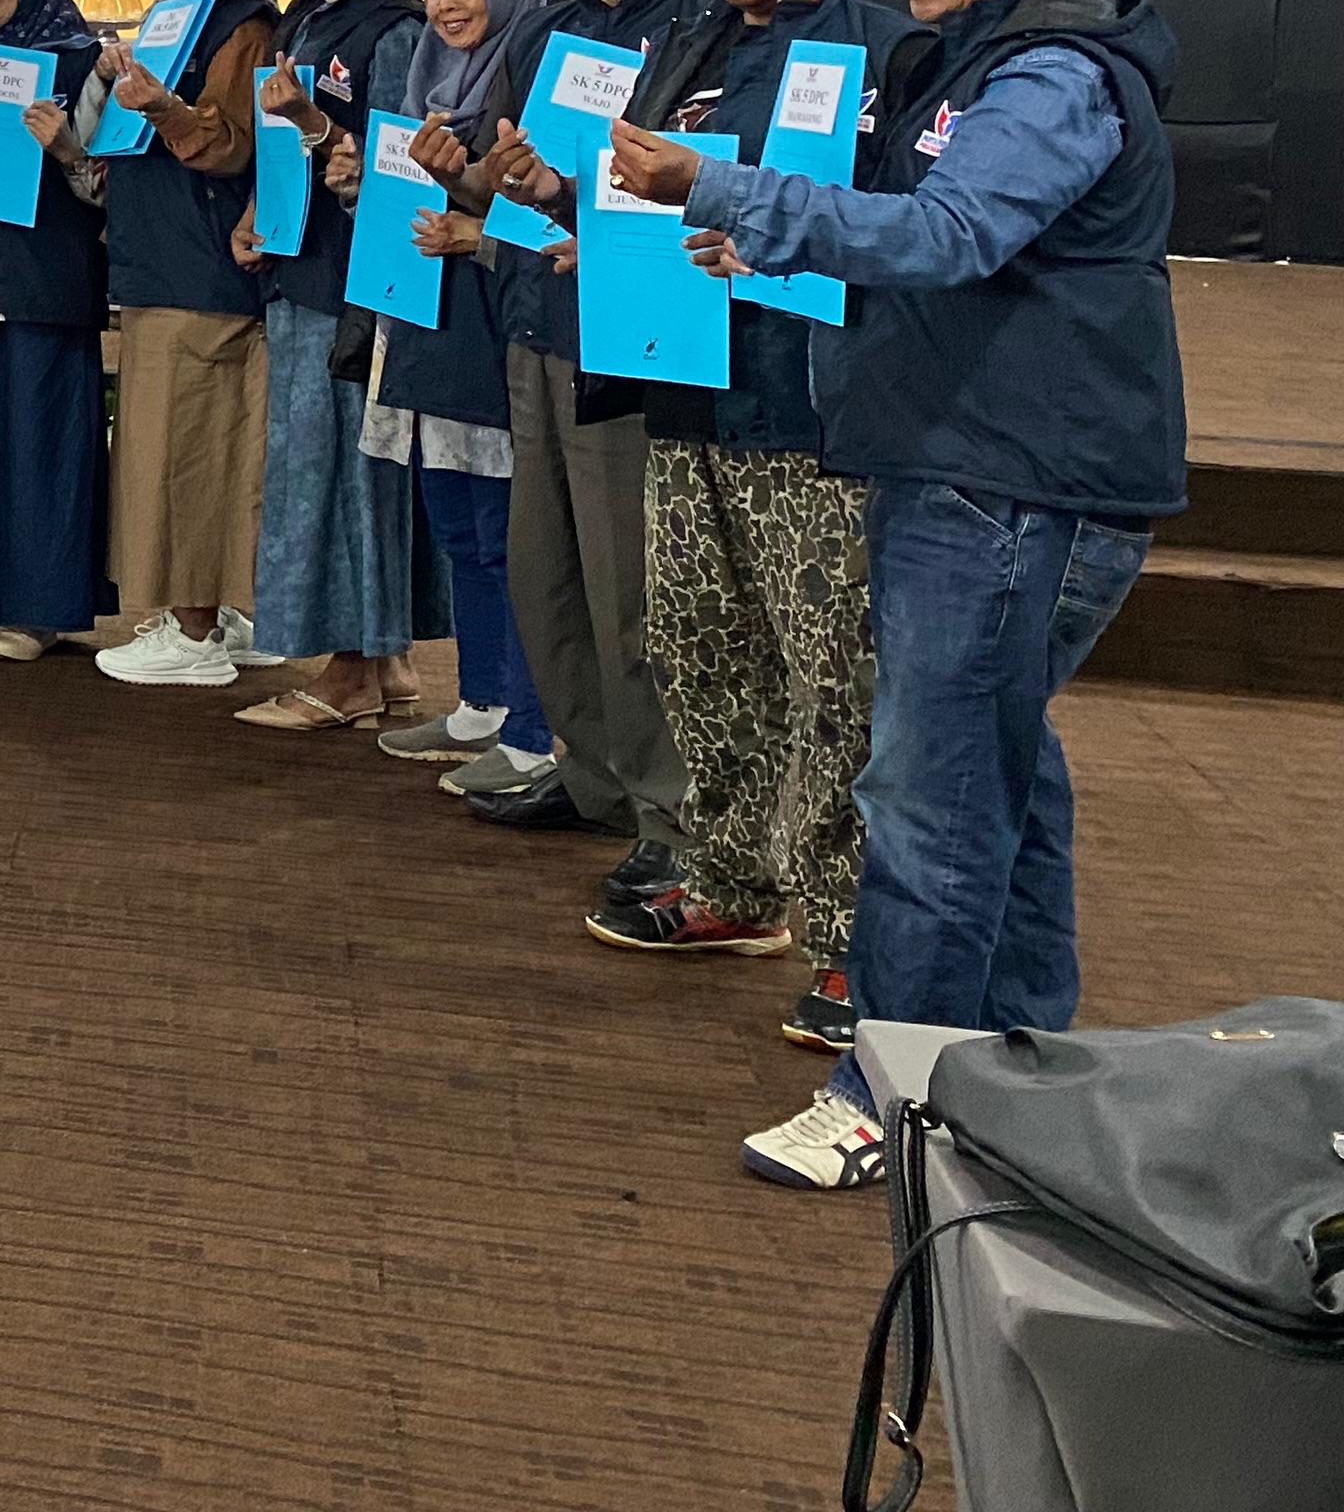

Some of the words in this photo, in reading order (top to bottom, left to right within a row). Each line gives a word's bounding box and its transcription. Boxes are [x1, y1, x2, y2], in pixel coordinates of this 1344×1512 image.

[2, 74, 25, 88] DPC
[571, 73, 592, 90] SK
[593, 79, 601, 92] 5
[603, 82, 633, 99] DPC
[583, 94, 611, 109] WAJO
[385, 143, 400, 156] SK
[399, 146, 407, 158] 5
[377, 158, 431, 182] BONTOALA
